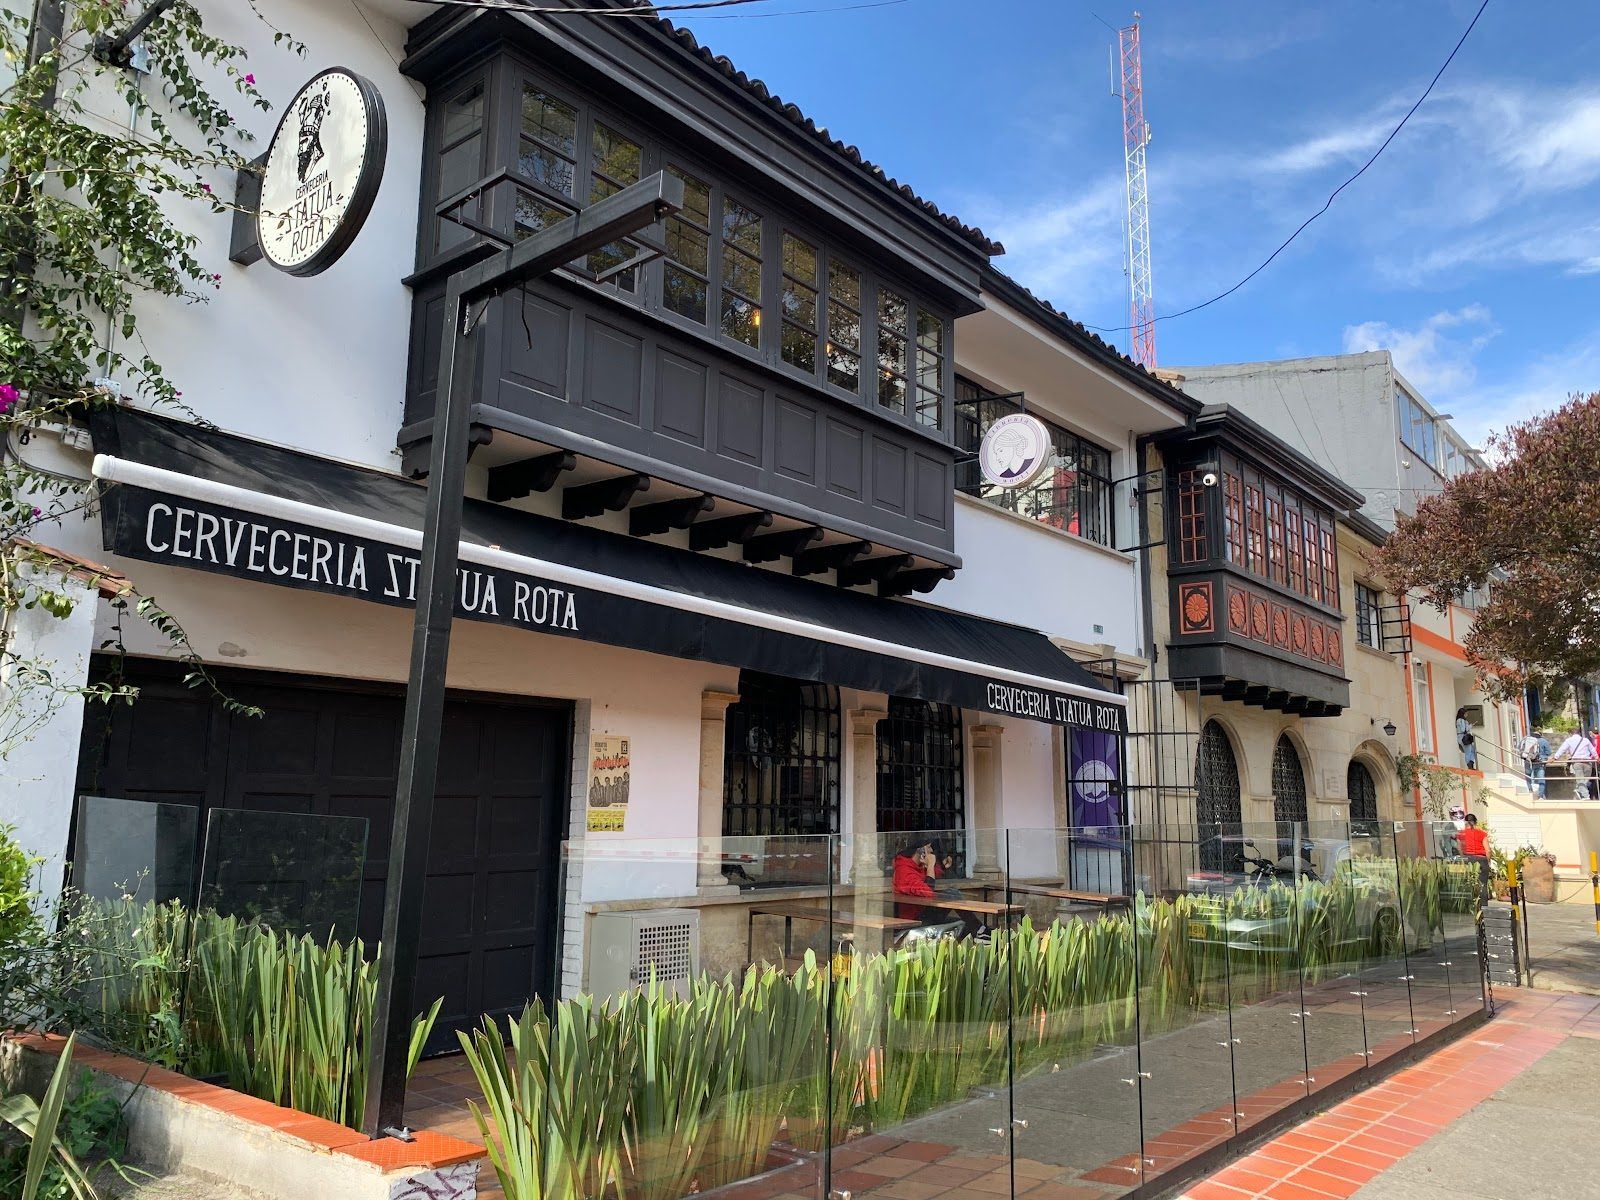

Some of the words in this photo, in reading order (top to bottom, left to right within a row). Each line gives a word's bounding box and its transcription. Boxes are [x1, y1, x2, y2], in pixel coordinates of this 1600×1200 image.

[286, 181, 333, 235] STATUA
[296, 169, 329, 200] CERVECERIA
[291, 214, 324, 257] ROTA
[145, 502, 368, 592] CERVECERIA
[383, 552, 500, 617] STUA
[512, 580, 580, 631] ROTA
[986, 682, 1052, 720] CERVECERIA
[1054, 696, 1093, 727] STATUA
[1096, 705, 1121, 732] ROTA
